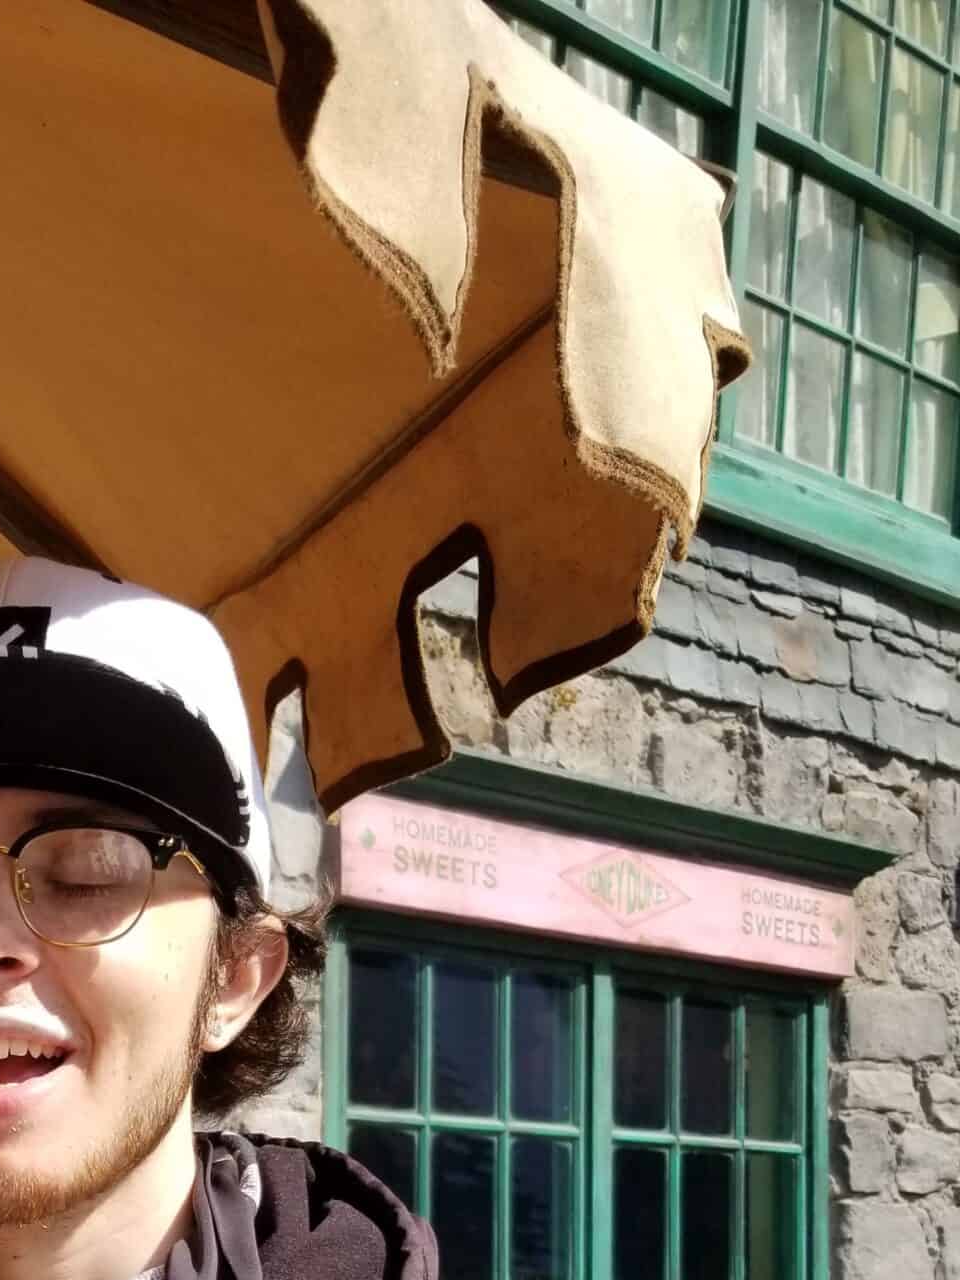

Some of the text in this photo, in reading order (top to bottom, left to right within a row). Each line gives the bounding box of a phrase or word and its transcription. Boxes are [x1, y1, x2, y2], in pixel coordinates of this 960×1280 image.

[392, 815, 498, 856] HOMEMADE
[394, 844, 497, 889] SWEETS
[743, 887, 822, 917] HOMEMADE
[742, 910, 821, 947] SWEETS
